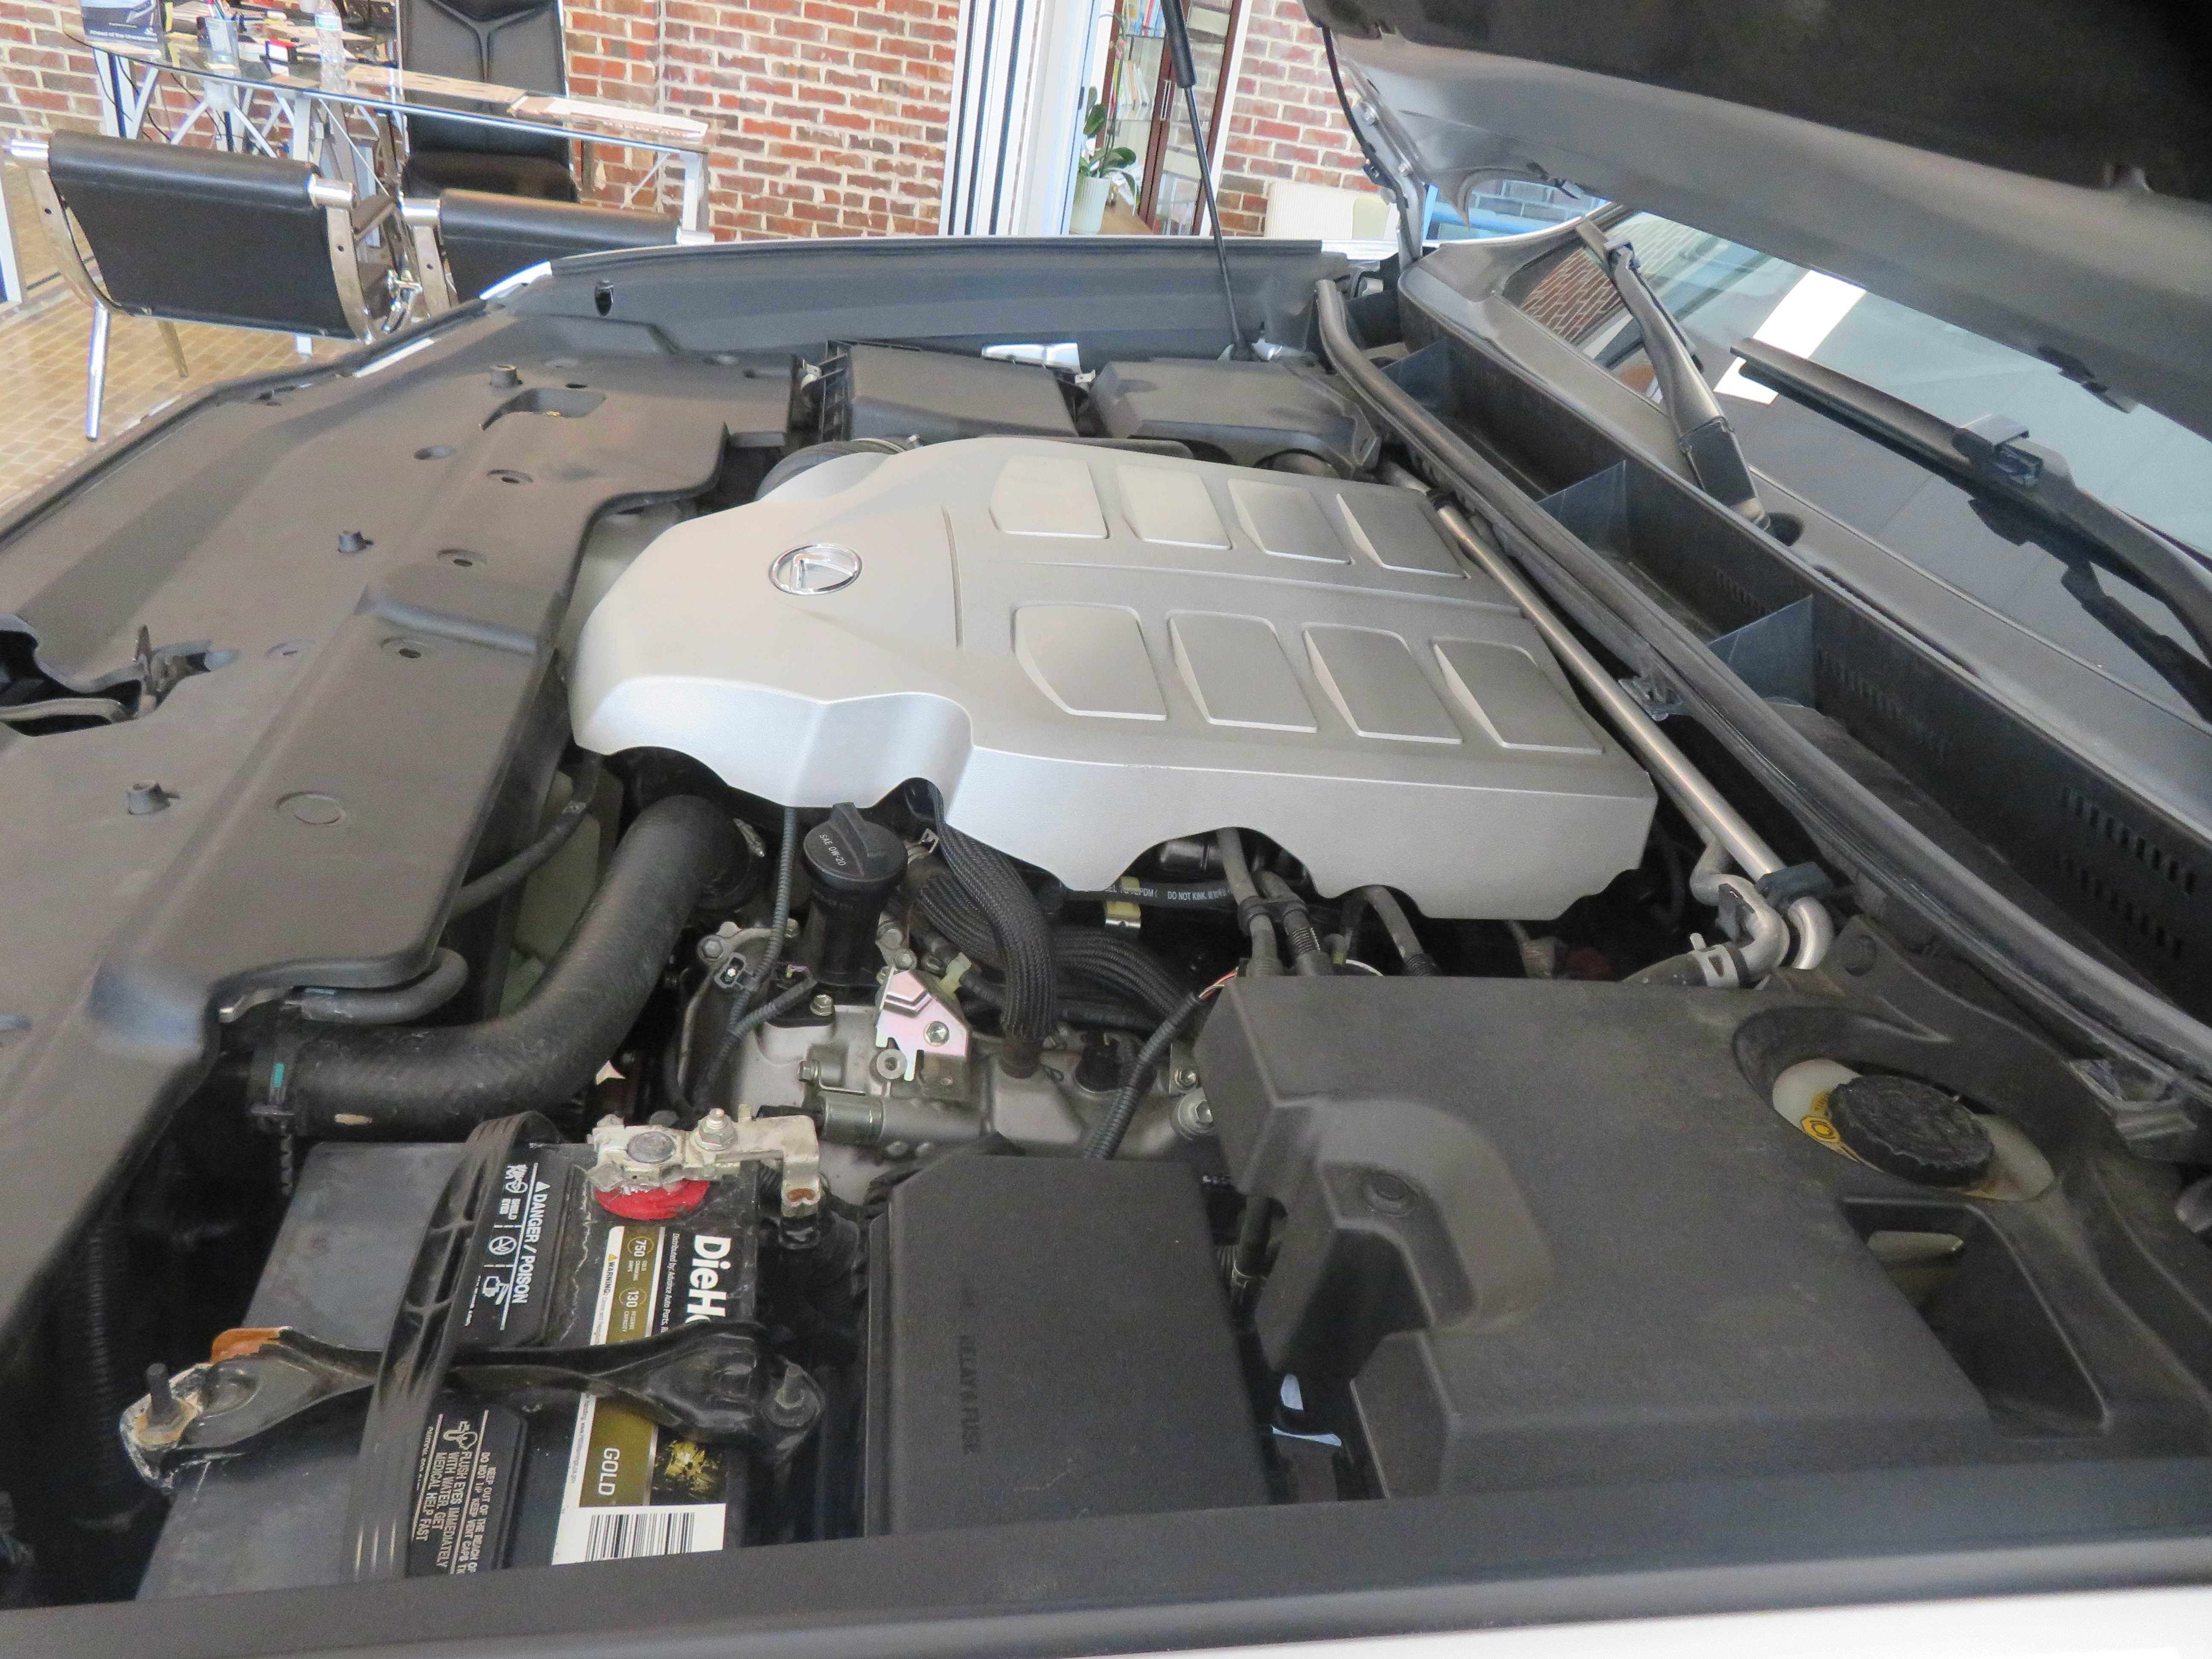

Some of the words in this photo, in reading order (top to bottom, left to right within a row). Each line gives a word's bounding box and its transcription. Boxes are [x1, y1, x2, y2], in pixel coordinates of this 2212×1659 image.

[819, 834, 832, 845] SAE
[828, 846, 846, 865] 0W-20
[1167, 891, 1177, 899] DO
[1179, 891, 1190, 900] NOT
[525, 1194, 548, 1243] DANGER
[634, 1240, 647, 1257] 750
[669, 1233, 680, 1262] Distributed
[512, 1256, 536, 1303] POISON
[603, 1262, 616, 1296] WARNING:
[665, 1272, 675, 1293] Advance
[626, 1291, 640, 1307] 130
[664, 1295, 672, 1308] Auto
[428, 1452, 446, 1489] MEDICAL
[445, 1452, 459, 1474] WITH
[456, 1451, 472, 1479] FLUSH
[598, 1448, 620, 1496] GOLD
[486, 1467, 496, 1485] KEEP
[437, 1476, 454, 1509] WATER.
[451, 1482, 466, 1504] EYES
[483, 1487, 492, 1502] OUT
[422, 1493, 437, 1516] HELP
[470, 1498, 480, 1517] KEEP
[479, 1505, 489, 1516] OF
[416, 1518, 432, 1541] FAST
[432, 1512, 446, 1530] GET
[465, 1519, 476, 1539] VENT
[475, 1518, 486, 1534] THE
[437, 1508, 461, 1567] IMMEDIATELY
